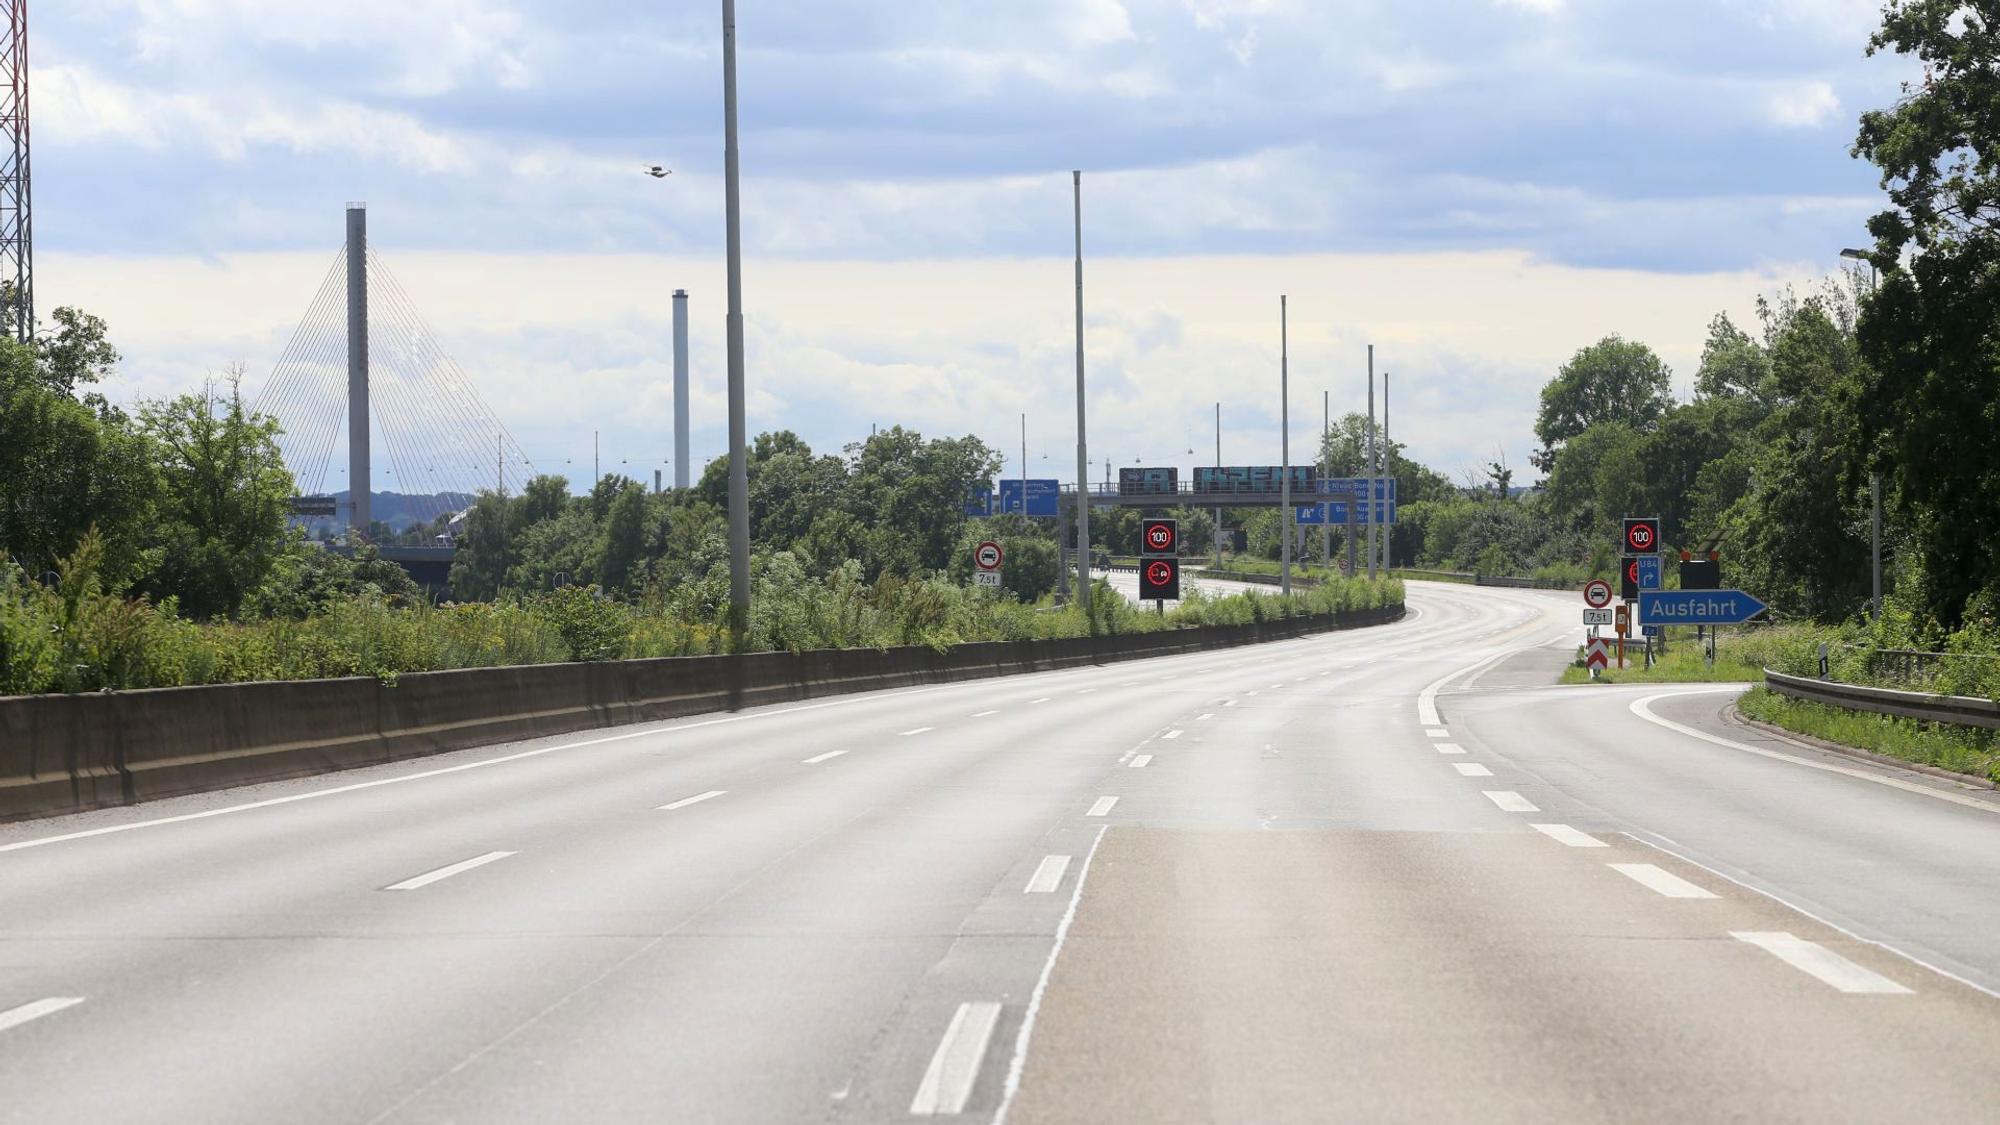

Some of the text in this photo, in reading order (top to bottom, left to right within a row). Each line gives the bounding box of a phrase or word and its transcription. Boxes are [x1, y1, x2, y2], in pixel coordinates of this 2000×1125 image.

[1151, 532, 1167, 542] 100
[1633, 531, 1649, 542] 100
[1649, 598, 1737, 617] Ausfahrt
